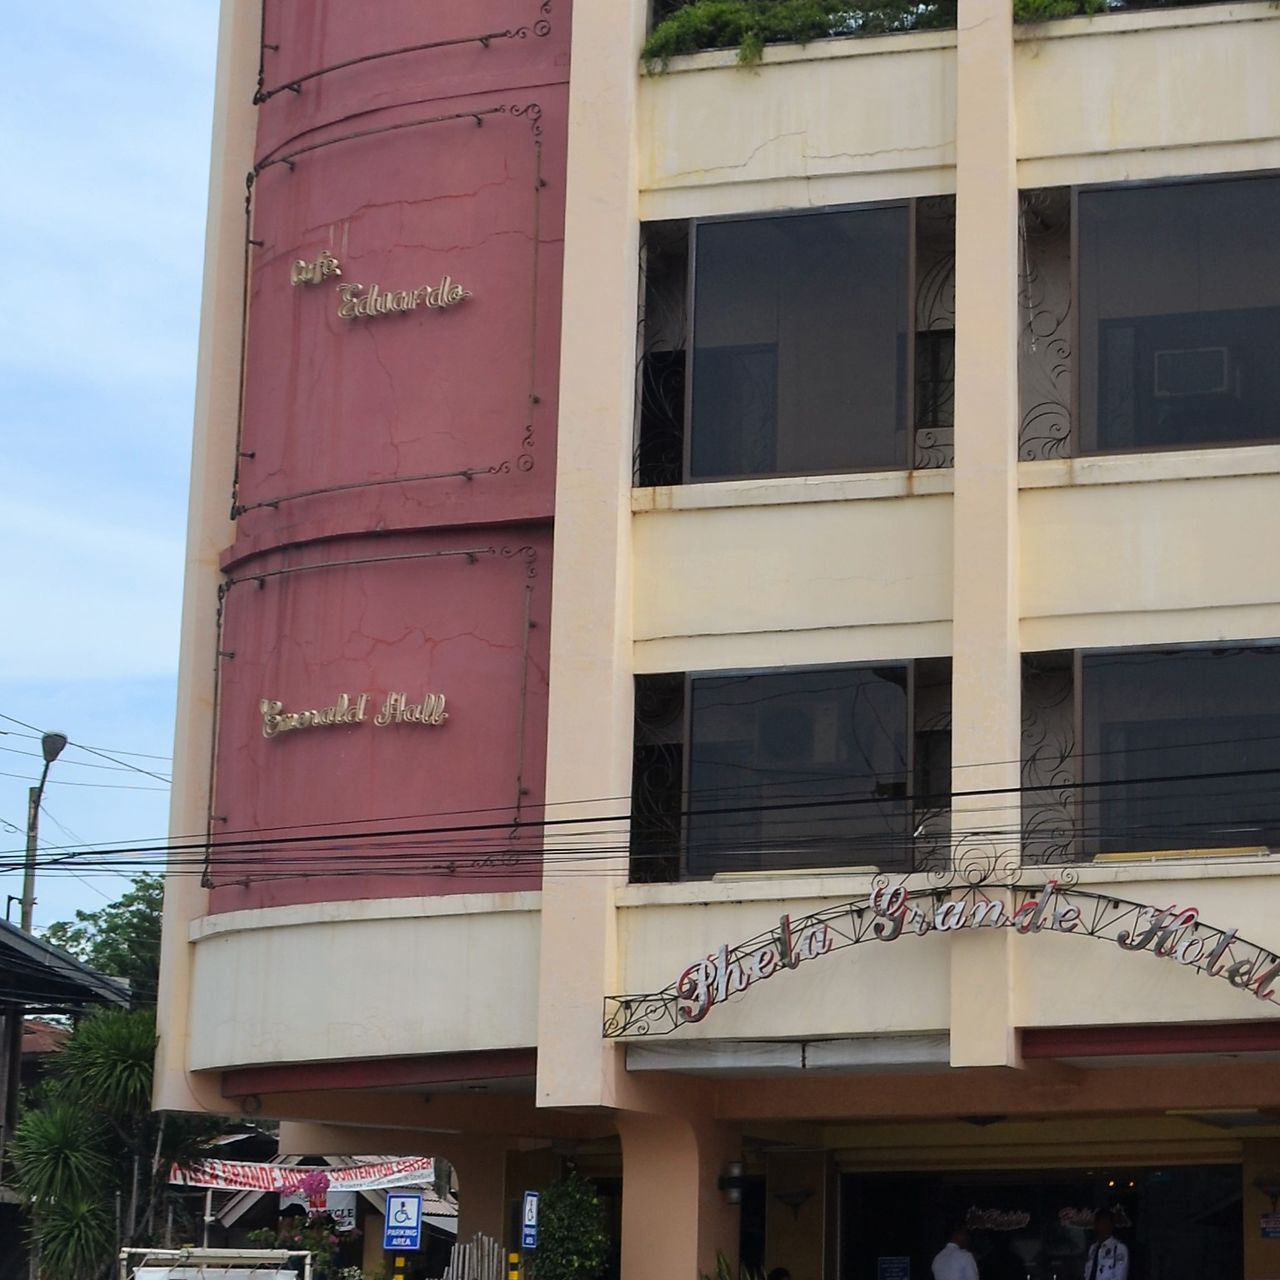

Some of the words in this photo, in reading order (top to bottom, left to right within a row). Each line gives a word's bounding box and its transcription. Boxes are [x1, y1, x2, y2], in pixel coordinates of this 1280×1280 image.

[336, 275, 473, 319] Eduardo
[259, 693, 371, 738] Emerald
[373, 691, 449, 727] Hall
[676, 912, 834, 1023] Phela
[869, 879, 1081, 942] Grande
[330, 1161, 394, 1182] CONVENTION
[396, 1156, 432, 1174] CENTER
[391, 1237, 412, 1246] AREA
